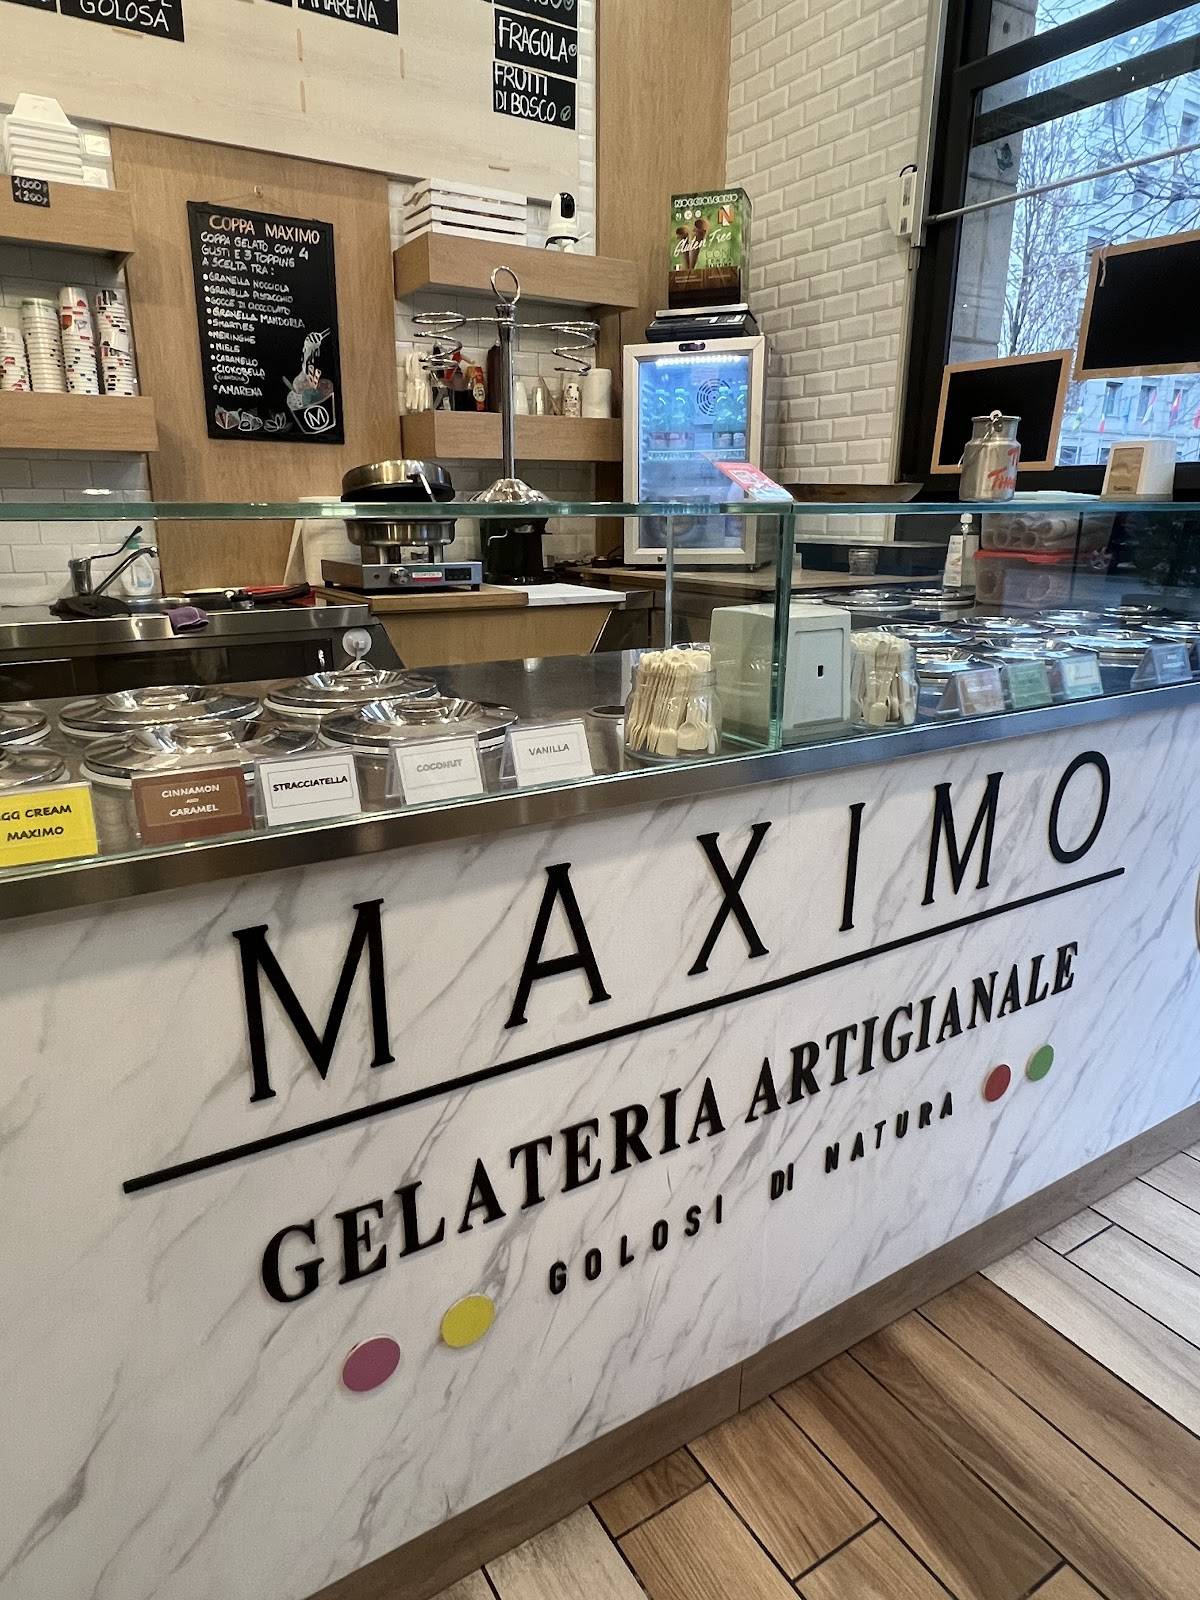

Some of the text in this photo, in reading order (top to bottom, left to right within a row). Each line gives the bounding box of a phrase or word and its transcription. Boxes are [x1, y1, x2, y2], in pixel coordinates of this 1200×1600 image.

[80, 0, 169, 32] GOLOSA
[301, 0, 379, 25] ARENA
[498, 16, 568, 64] FRAGOLA
[494, 63, 547, 96] FRUTTI
[495, 90, 556, 122] DI BOSCO
[209, 215, 320, 245] COPPA MAXIMO
[200, 231, 309, 260] COPPA GELATO CON 4
[674, 228, 732, 257] Gluten Free
[201, 244, 295, 268] GUSTI E 3 TOPPING
[202, 256, 209, 267] A
[212, 258, 247, 271] SCELTA
[209, 272, 290, 293] GRANELLA NOCCIOLA
[210, 285, 249, 298] GRANELLA
[211, 297, 235, 308] GOCCE
[212, 306, 305, 329] GRANELLA MANDORLA
[212, 318, 255, 332] SMARTIES
[212, 330, 256, 344] MERINGHE
[218, 384, 263, 397] AMARENA
[528, 742, 570, 757] VANILLA
[416, 758, 463, 773] COCONUT
[161, 784, 220, 798] CINNAMON
[272, 774, 348, 793] STRACCIATELLA
[0, 804, 72, 821] GG CREAM
[169, 804, 219, 817] CARAMEL
[7, 826, 64, 842] MAXIMO
[232, 750, 1111, 1104] MAXIMO
[261, 941, 1078, 1304] GELATERIA ARTIGIANALE
[548, 1092, 953, 1295] GOLOSI DI NATURA
